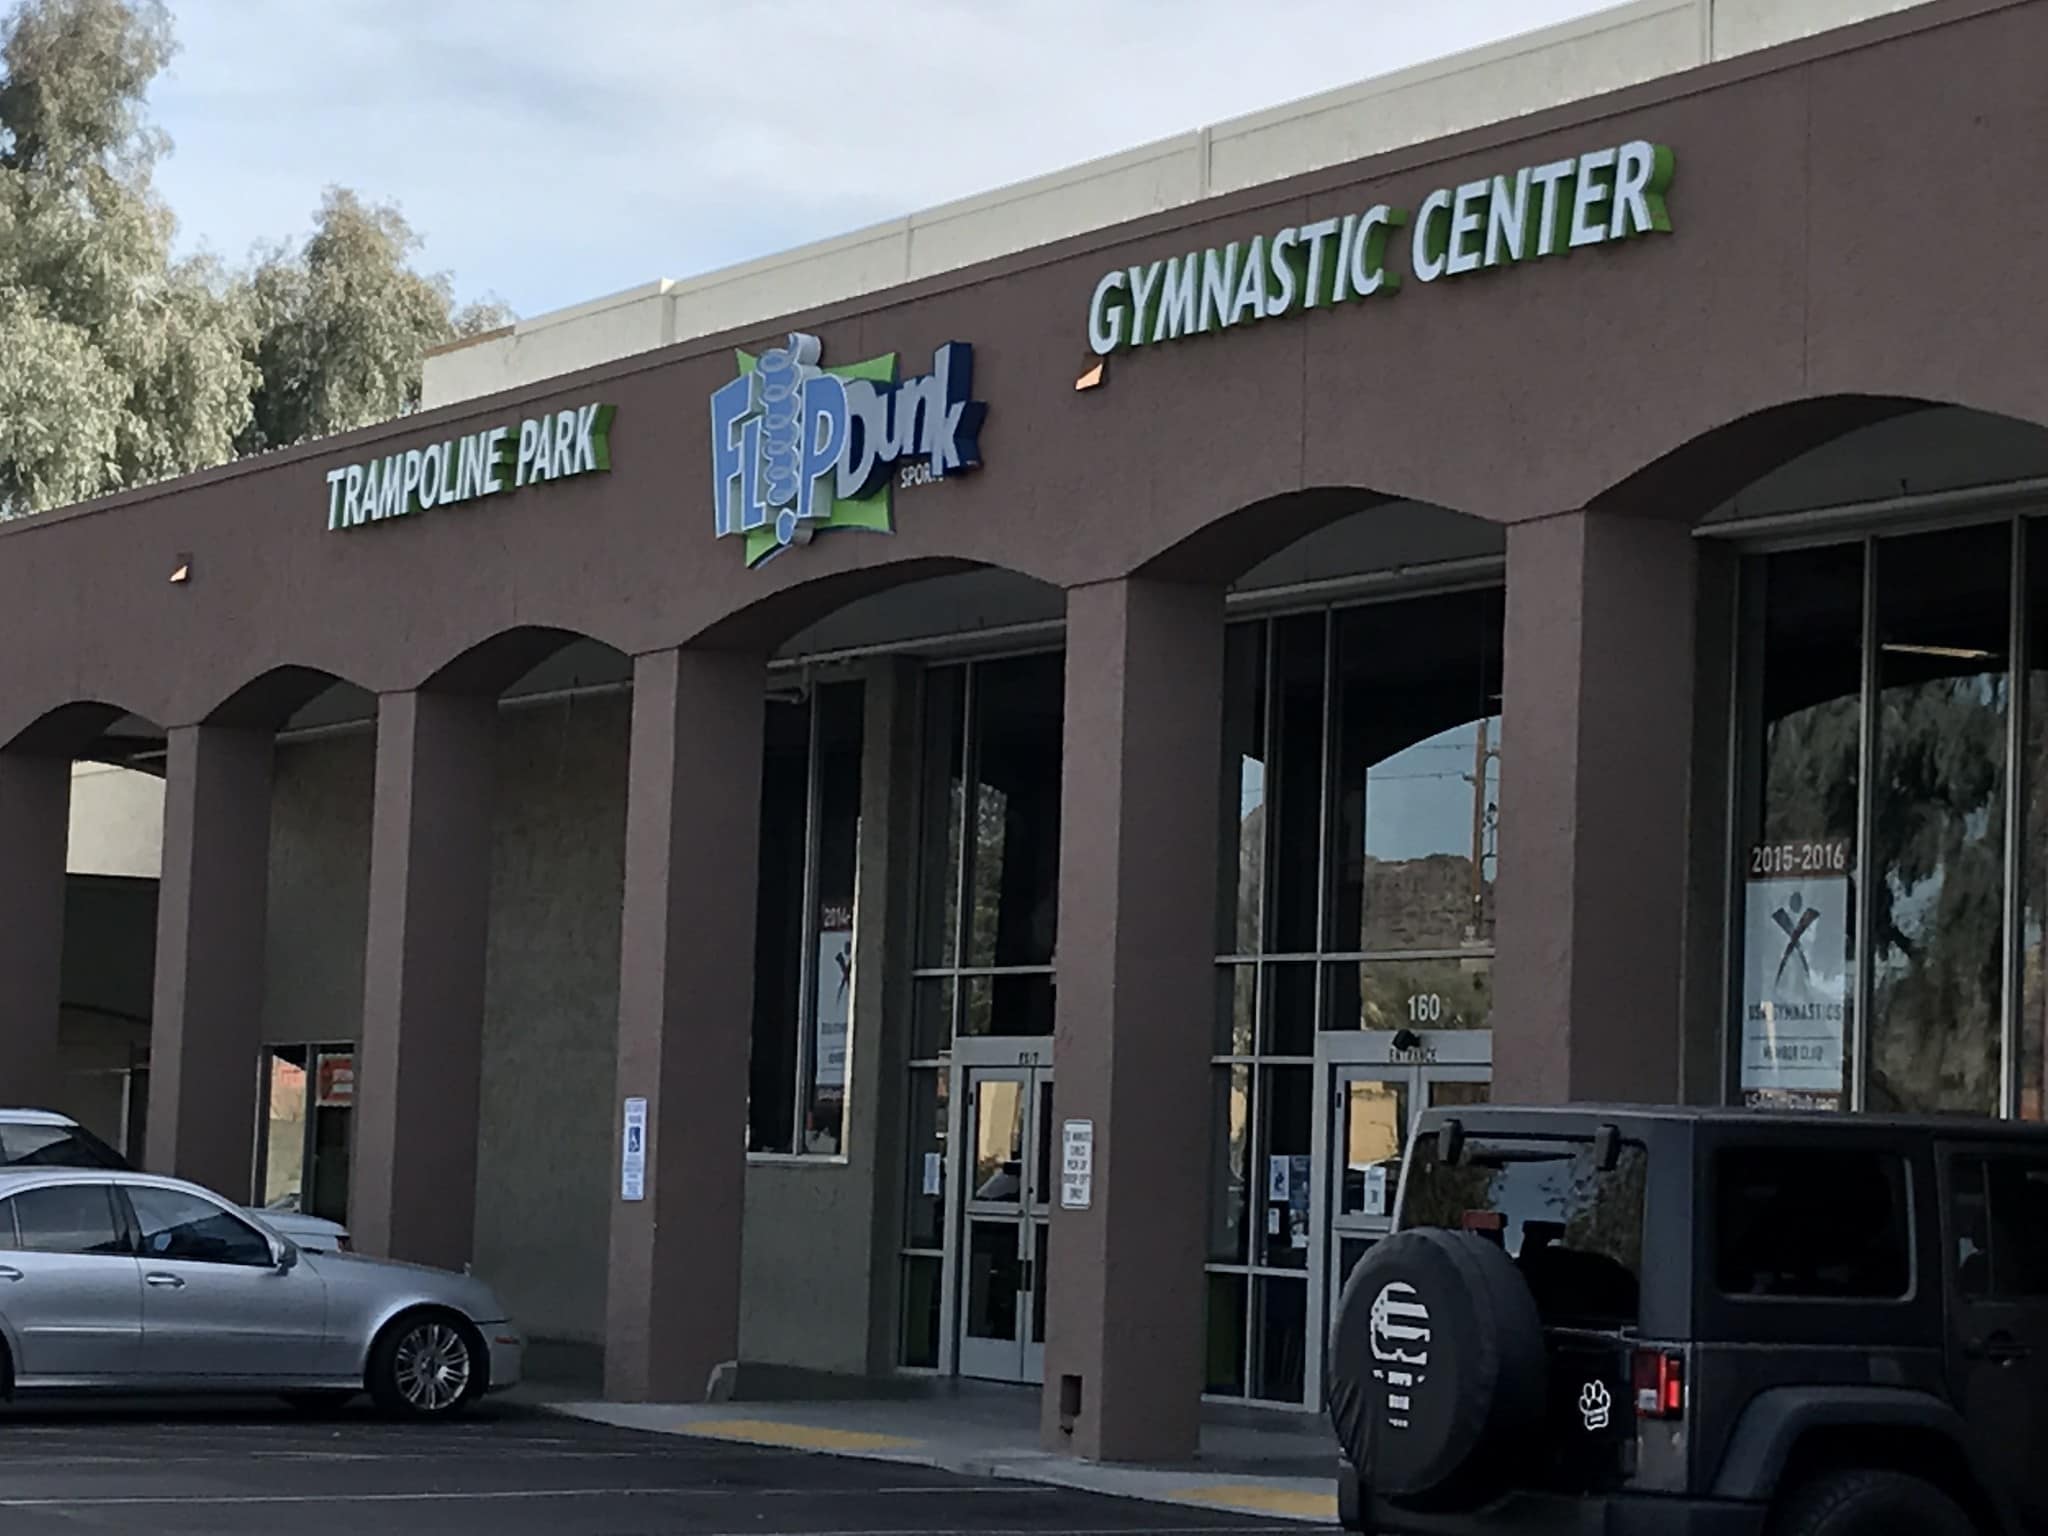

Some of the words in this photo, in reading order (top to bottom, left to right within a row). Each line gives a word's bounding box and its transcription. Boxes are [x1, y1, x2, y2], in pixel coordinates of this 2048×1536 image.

[1087, 204, 1392, 355] GYMNASTIC
[1411, 139, 1656, 283] CENTER
[326, 426, 508, 530] TRAMPOLINE
[514, 402, 601, 487] PARK
[901, 462, 943, 488] SPOR
[1751, 843, 1845, 873] 2015-2016
[1407, 992, 1440, 1021] 160
